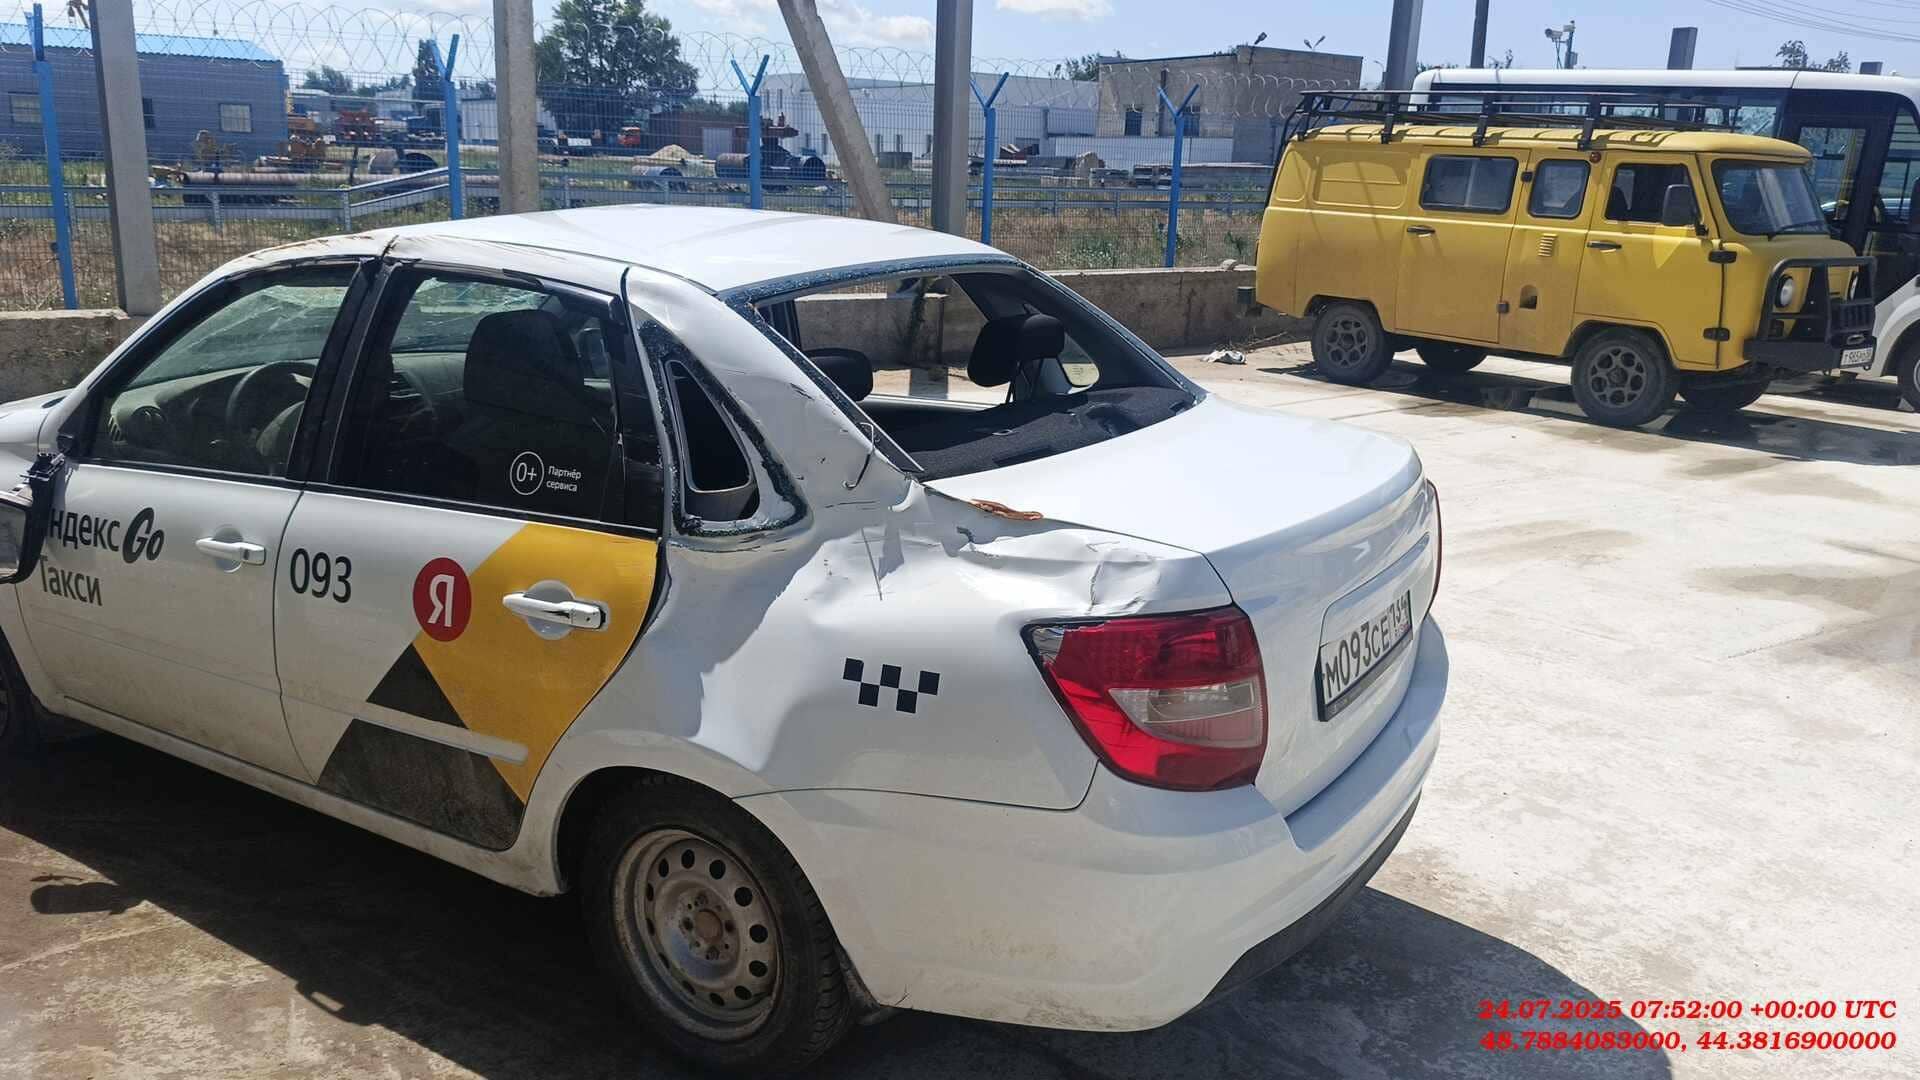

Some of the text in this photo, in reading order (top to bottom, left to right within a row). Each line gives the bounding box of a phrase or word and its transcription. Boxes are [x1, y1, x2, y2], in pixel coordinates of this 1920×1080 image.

[516, 462, 537, 482] 0+
[546, 480, 578, 492] сервиса
[548, 465, 582, 480] Партнёр
[50, 507, 165, 564] ндекс Go
[40, 554, 103, 606] Такси
[290, 548, 352, 604] 093
[427, 573, 455, 628] Я
